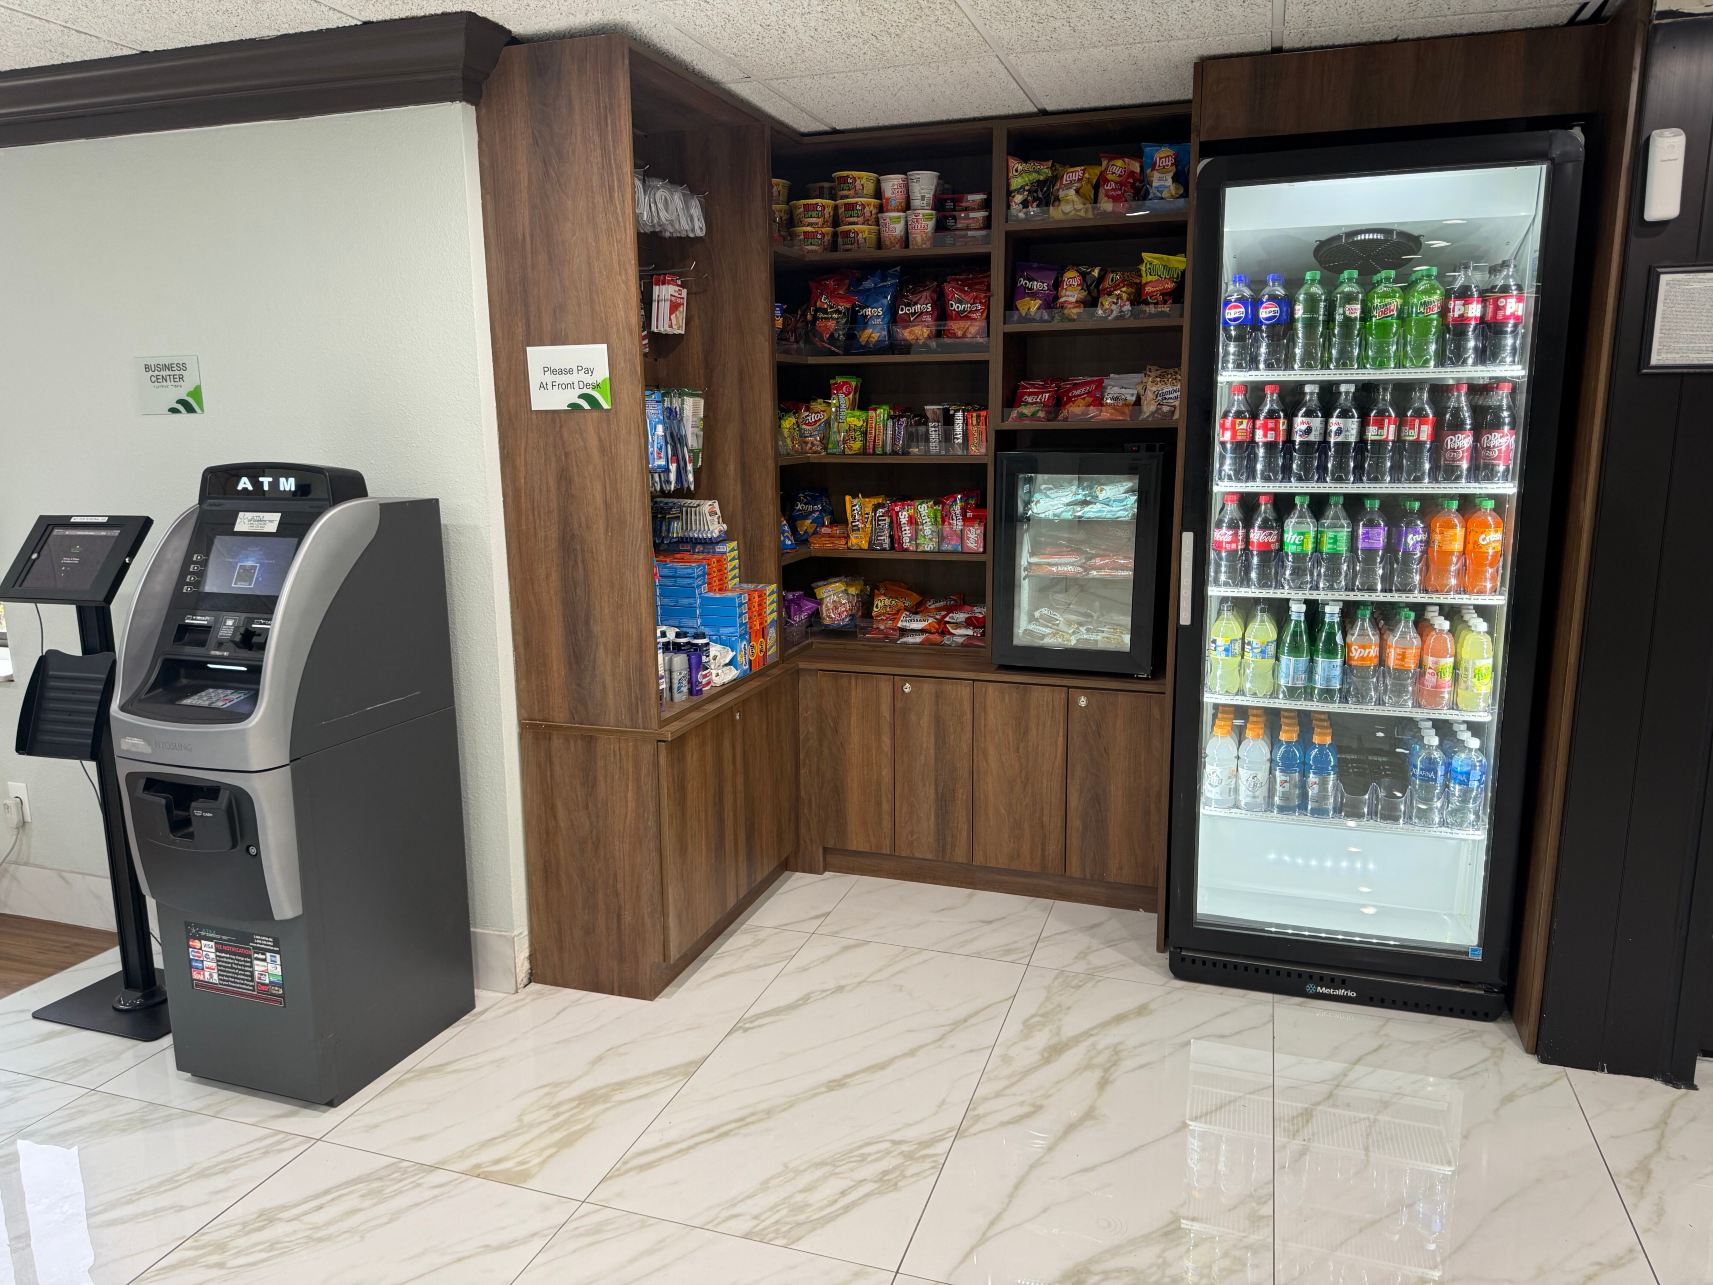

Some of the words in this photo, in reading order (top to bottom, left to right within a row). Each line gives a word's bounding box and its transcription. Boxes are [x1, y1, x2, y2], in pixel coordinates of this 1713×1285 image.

[1063, 170, 1084, 184] Lay's
[1017, 277, 1048, 291] Doritos
[899, 303, 932, 315] Doritos
[949, 301, 981, 311] Doritos
[144, 362, 188, 373] BUSINESS
[542, 366, 574, 376] Please
[576, 365, 595, 377] Pay
[149, 373, 185, 384] CENTER
[538, 381, 549, 391] At
[551, 381, 575, 391] Front
[577, 379, 602, 390] Desk
[953, 410, 963, 444] HERSHEY'S
[1455, 434, 1466, 442] Dr
[1491, 432, 1504, 441] Dr
[236, 476, 297, 492] ATM
[899, 510, 911, 548] Skittles
[1316, 986, 1357, 997] Metalfrio
